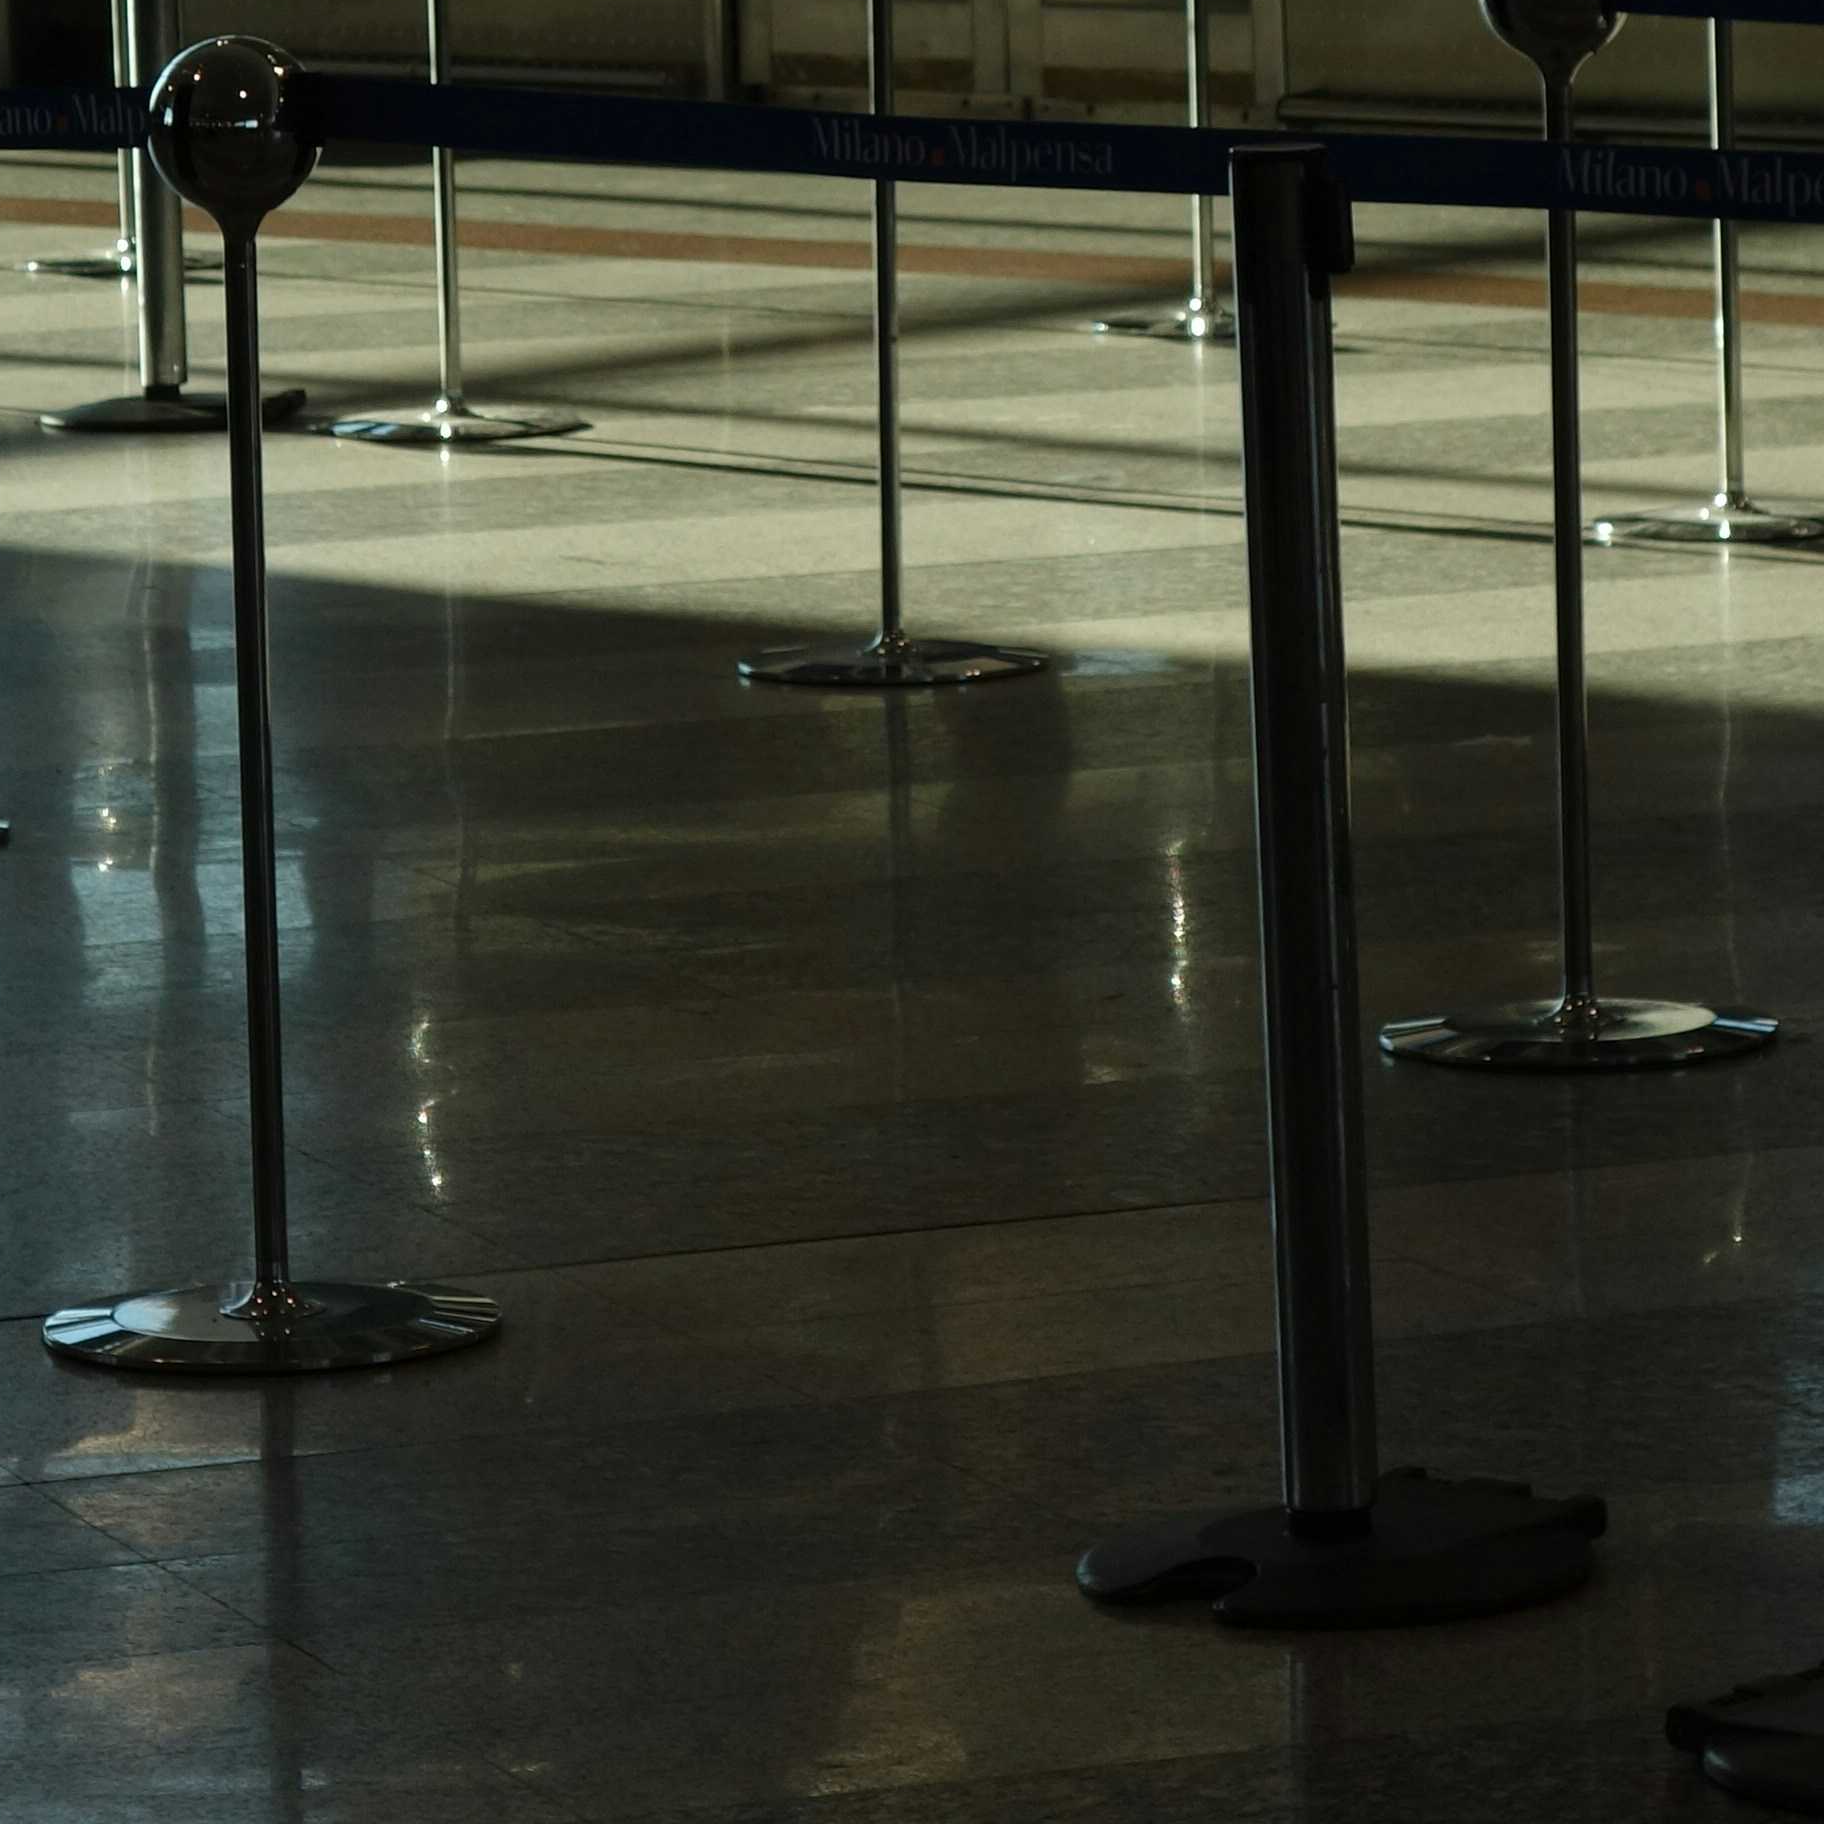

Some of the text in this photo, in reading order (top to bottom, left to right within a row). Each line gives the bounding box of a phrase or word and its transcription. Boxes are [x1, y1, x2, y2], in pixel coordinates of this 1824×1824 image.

[71, 91, 148, 148] Malp
[807, 115, 1114, 183] Milano Malpensa
[1559, 146, 1689, 200] Milano
